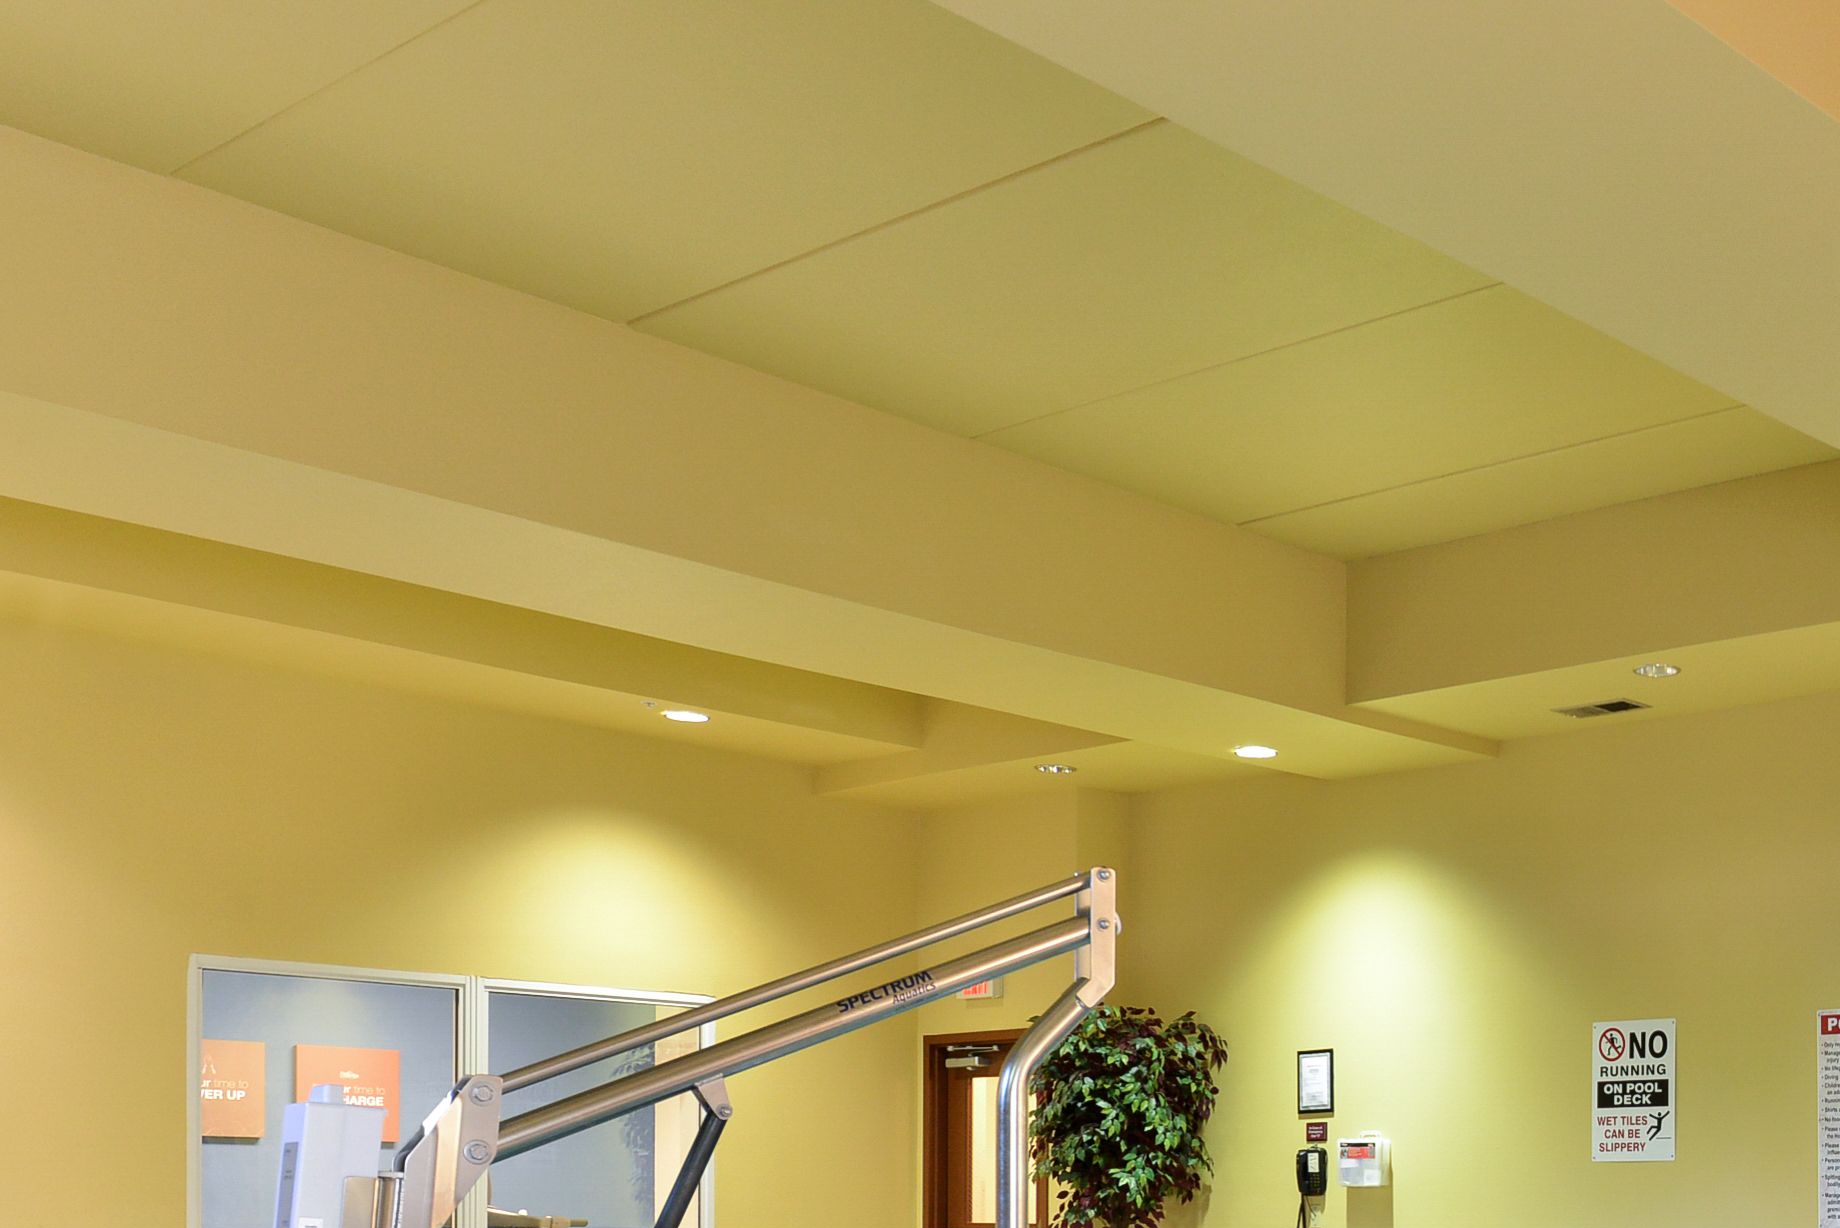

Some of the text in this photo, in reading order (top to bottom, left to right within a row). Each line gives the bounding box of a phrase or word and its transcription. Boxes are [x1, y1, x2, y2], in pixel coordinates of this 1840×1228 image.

[836, 970, 932, 1013] SPECTRUM
[892, 981, 936, 1004] Aquatics
[1629, 1030, 1668, 1059] NO
[1600, 1064, 1666, 1077] RUNNING
[238, 1080, 249, 1089] to
[1604, 1082, 1662, 1094] ON POOL
[227, 1089, 246, 1100] UP
[1614, 1094, 1652, 1105] DECK
[1597, 1115, 1648, 1126] WET TILES
[1604, 1129, 1640, 1139] CAN BE
[1599, 1142, 1646, 1152] SLIPPERY
